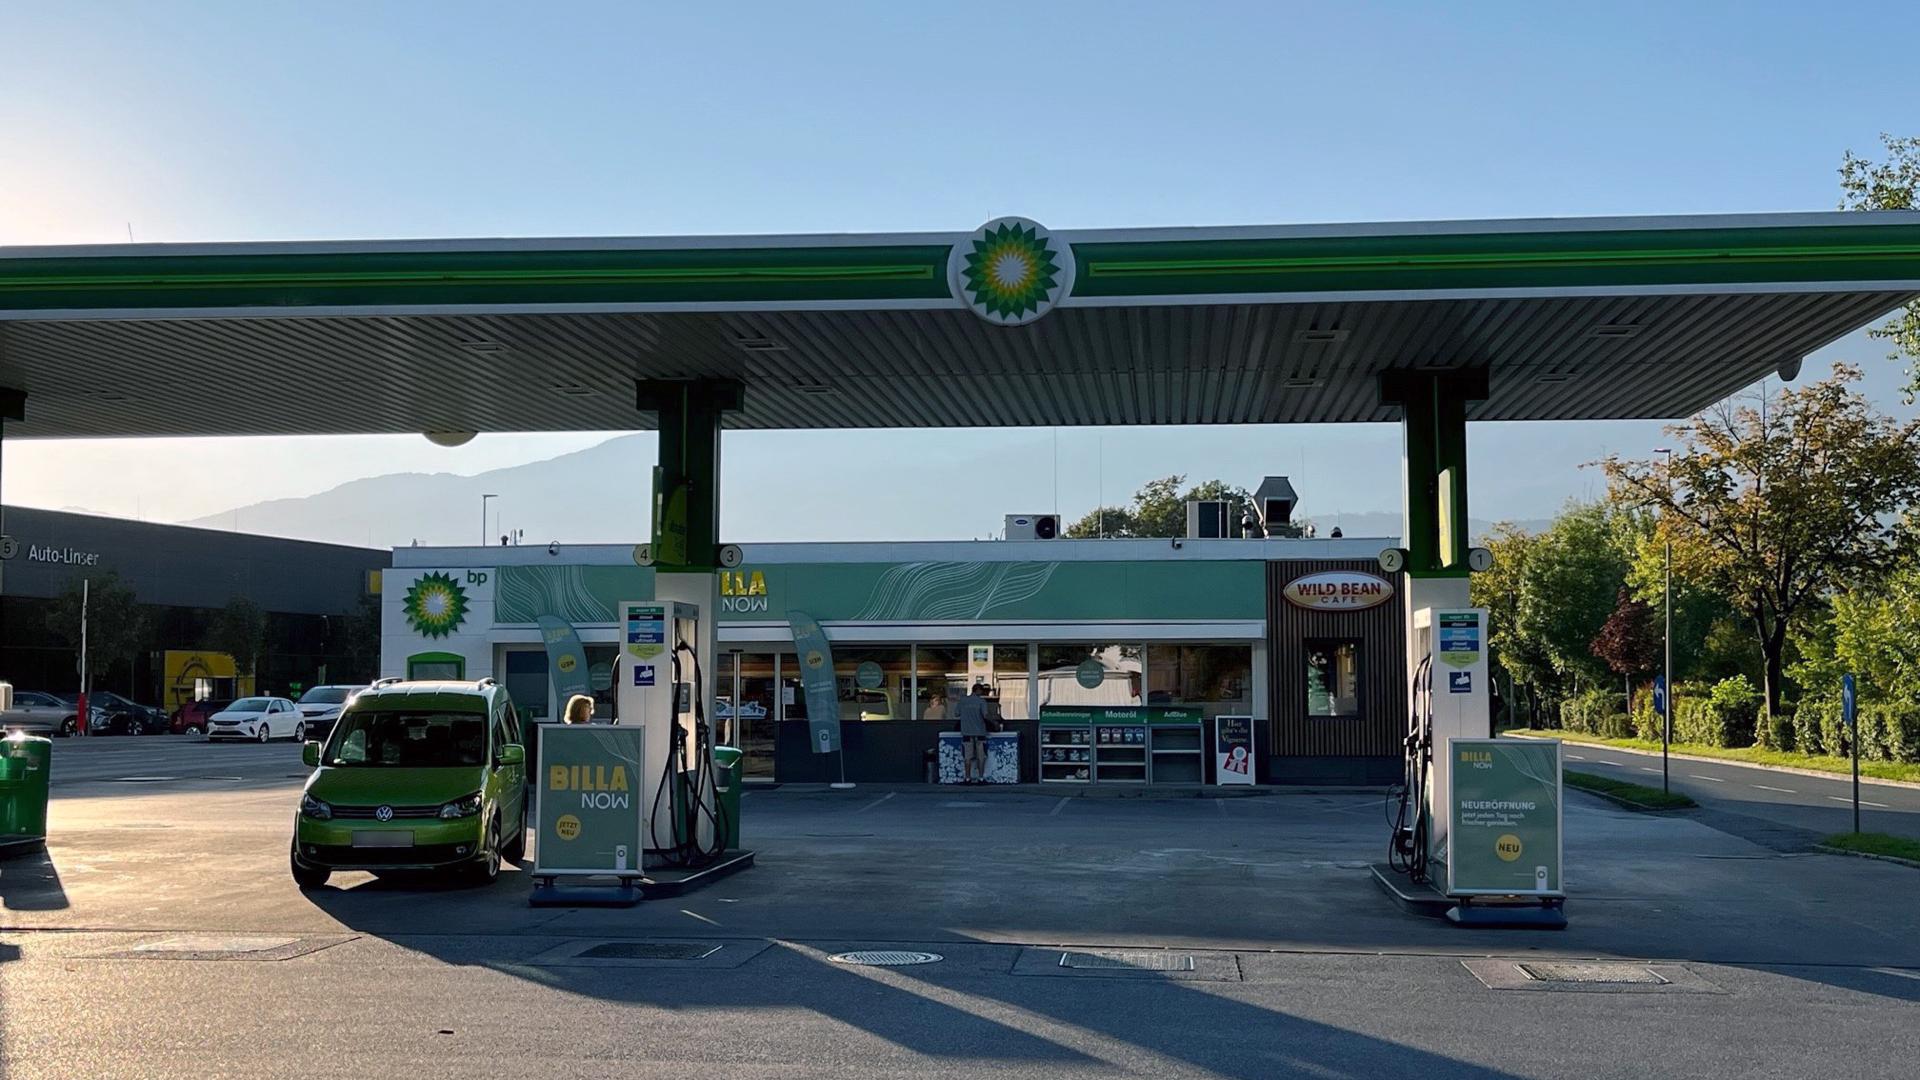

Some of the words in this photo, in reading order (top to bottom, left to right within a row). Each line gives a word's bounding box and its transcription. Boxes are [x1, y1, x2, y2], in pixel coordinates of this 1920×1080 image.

[3, 542, 11, 554] 5
[28, 544, 100, 566] Auto-Linser
[640, 549, 648, 560] 4
[727, 550, 734, 562] 3
[1387, 554, 1394, 567] 2
[1477, 554, 1483, 566] 1
[467, 570, 488, 586] bp
[721, 571, 768, 595] LLA
[1297, 584, 1337, 596] WILD
[1341, 583, 1381, 595] BEAN
[722, 597, 768, 612] NOW
[1321, 596, 1358, 604] CAFE
[1105, 710, 1137, 718] Motoröl
[1460, 752, 1492, 762] BILLA
[549, 765, 629, 791] BILLA
[581, 792, 629, 809] NOW
[1461, 799, 1536, 810] NEUERÖFFNUNG
[559, 821, 578, 829] JETZT
[1498, 843, 1520, 853] NEU
